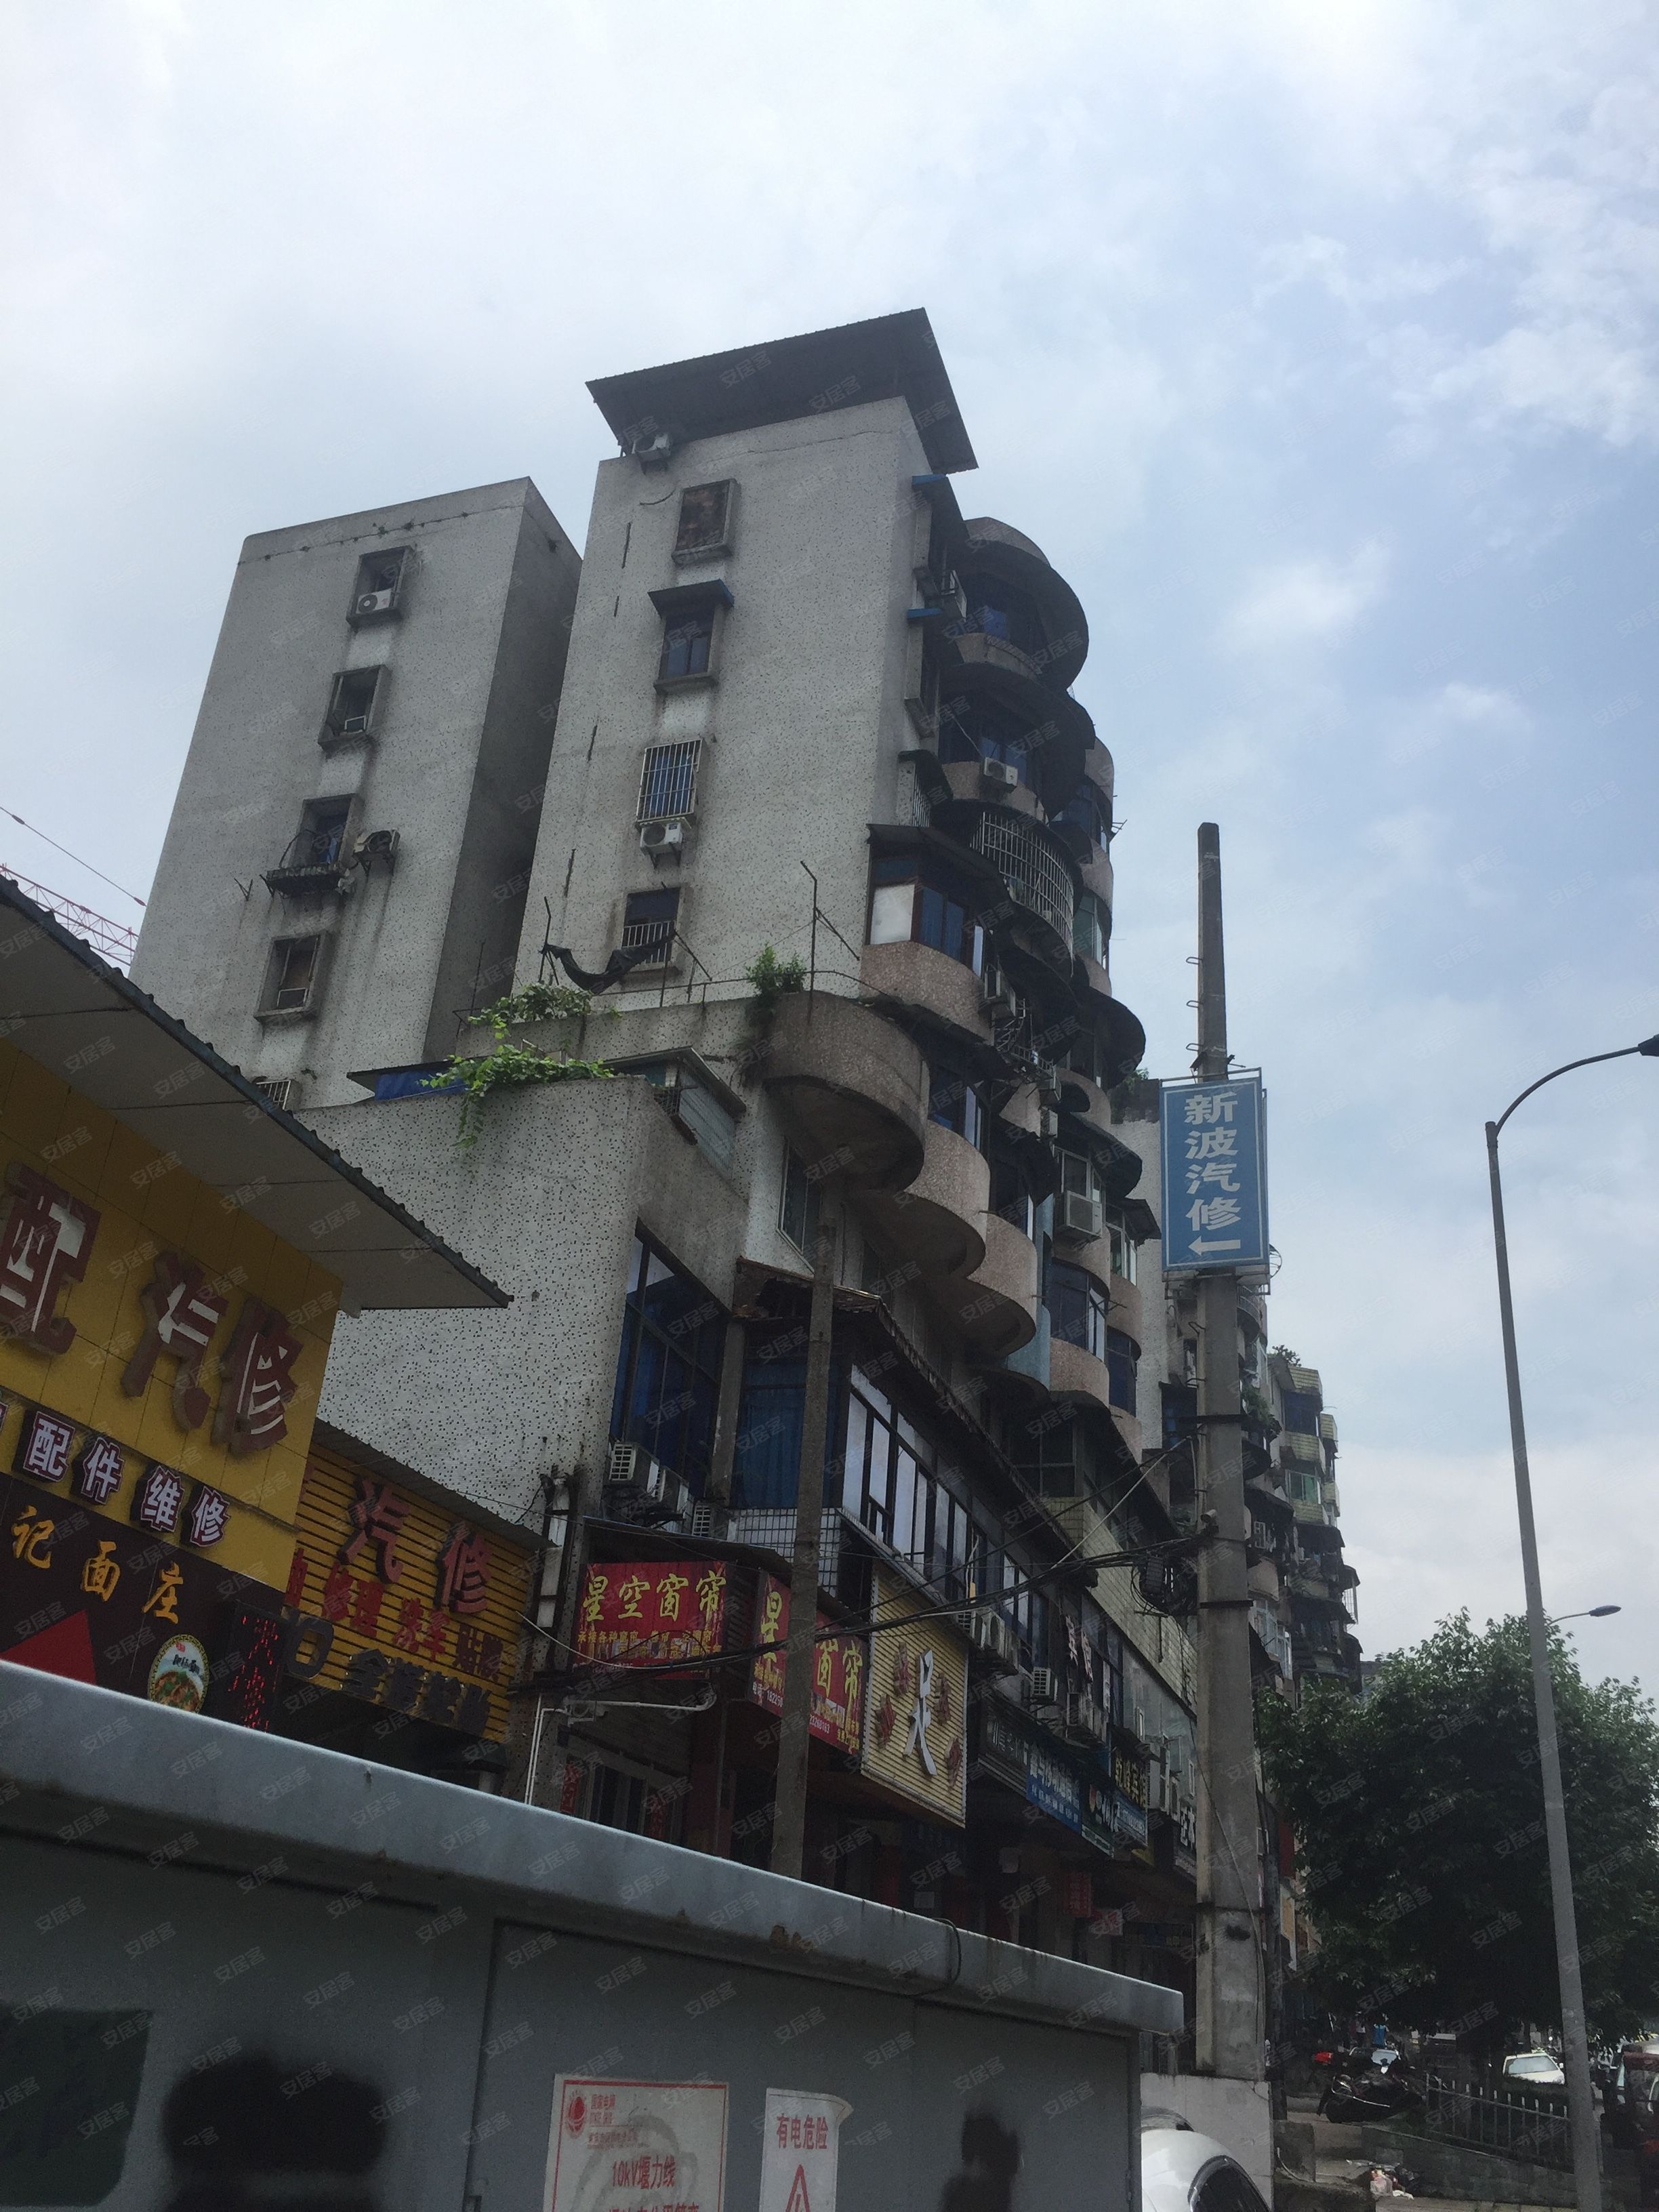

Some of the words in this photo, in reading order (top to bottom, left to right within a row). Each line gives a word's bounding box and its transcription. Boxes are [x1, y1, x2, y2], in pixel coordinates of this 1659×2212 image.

[1184, 1091, 1242, 1231] 新波汽修
[0, 1403, 230, 1548] 配件维修
[303, 1464, 491, 1614] 汽修
[12, 1504, 184, 1625] 记面庄
[582, 1570, 727, 1623] 星空窗帘
[776, 2114, 829, 2150] 有电危险
